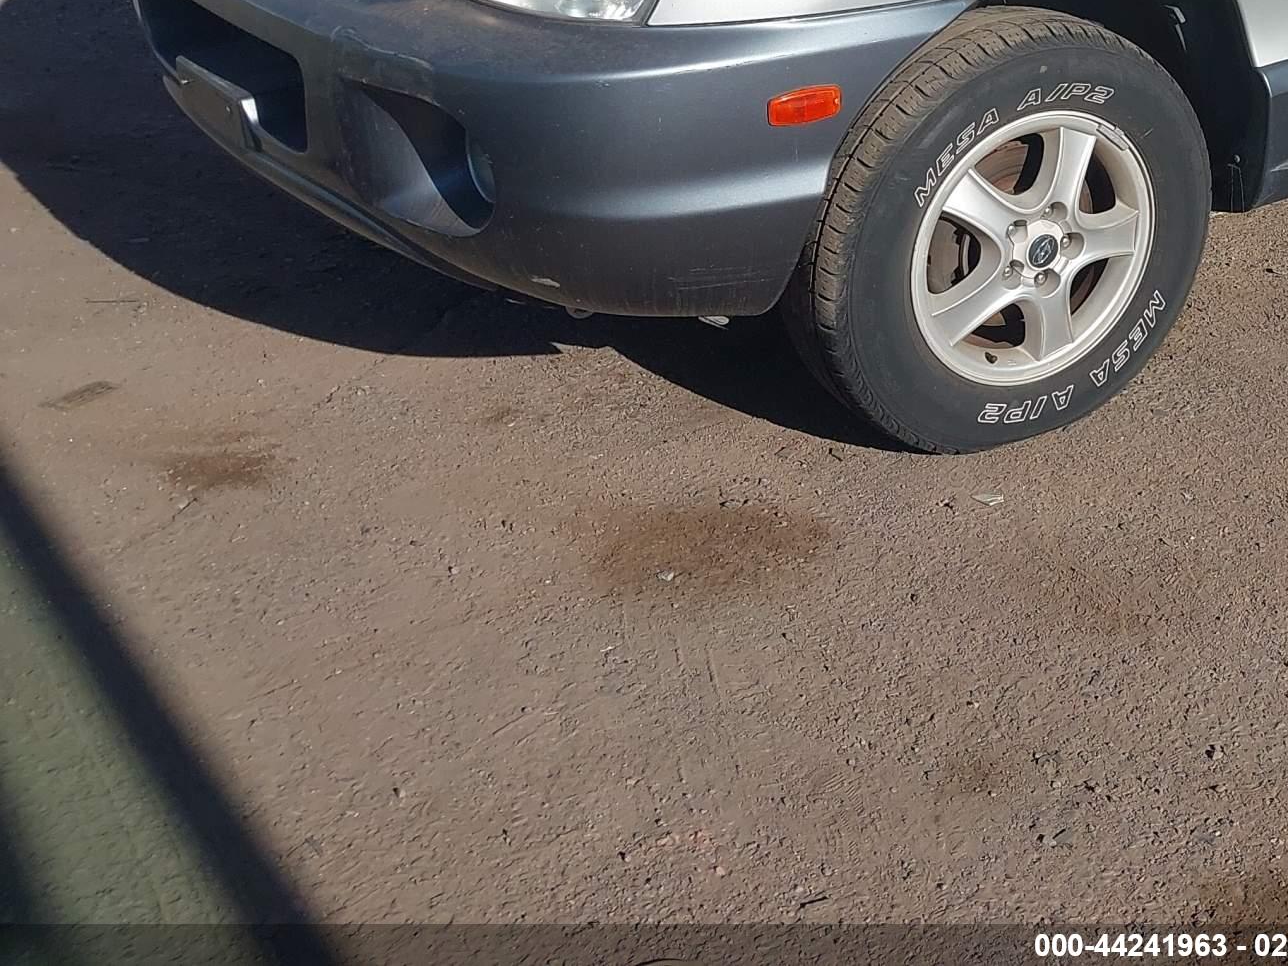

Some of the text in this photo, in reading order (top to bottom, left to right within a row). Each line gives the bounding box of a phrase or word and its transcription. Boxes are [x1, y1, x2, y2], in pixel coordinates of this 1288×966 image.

[914, 81, 1116, 208] MESA A/P2
[977, 290, 1167, 425] MESA A/P2
